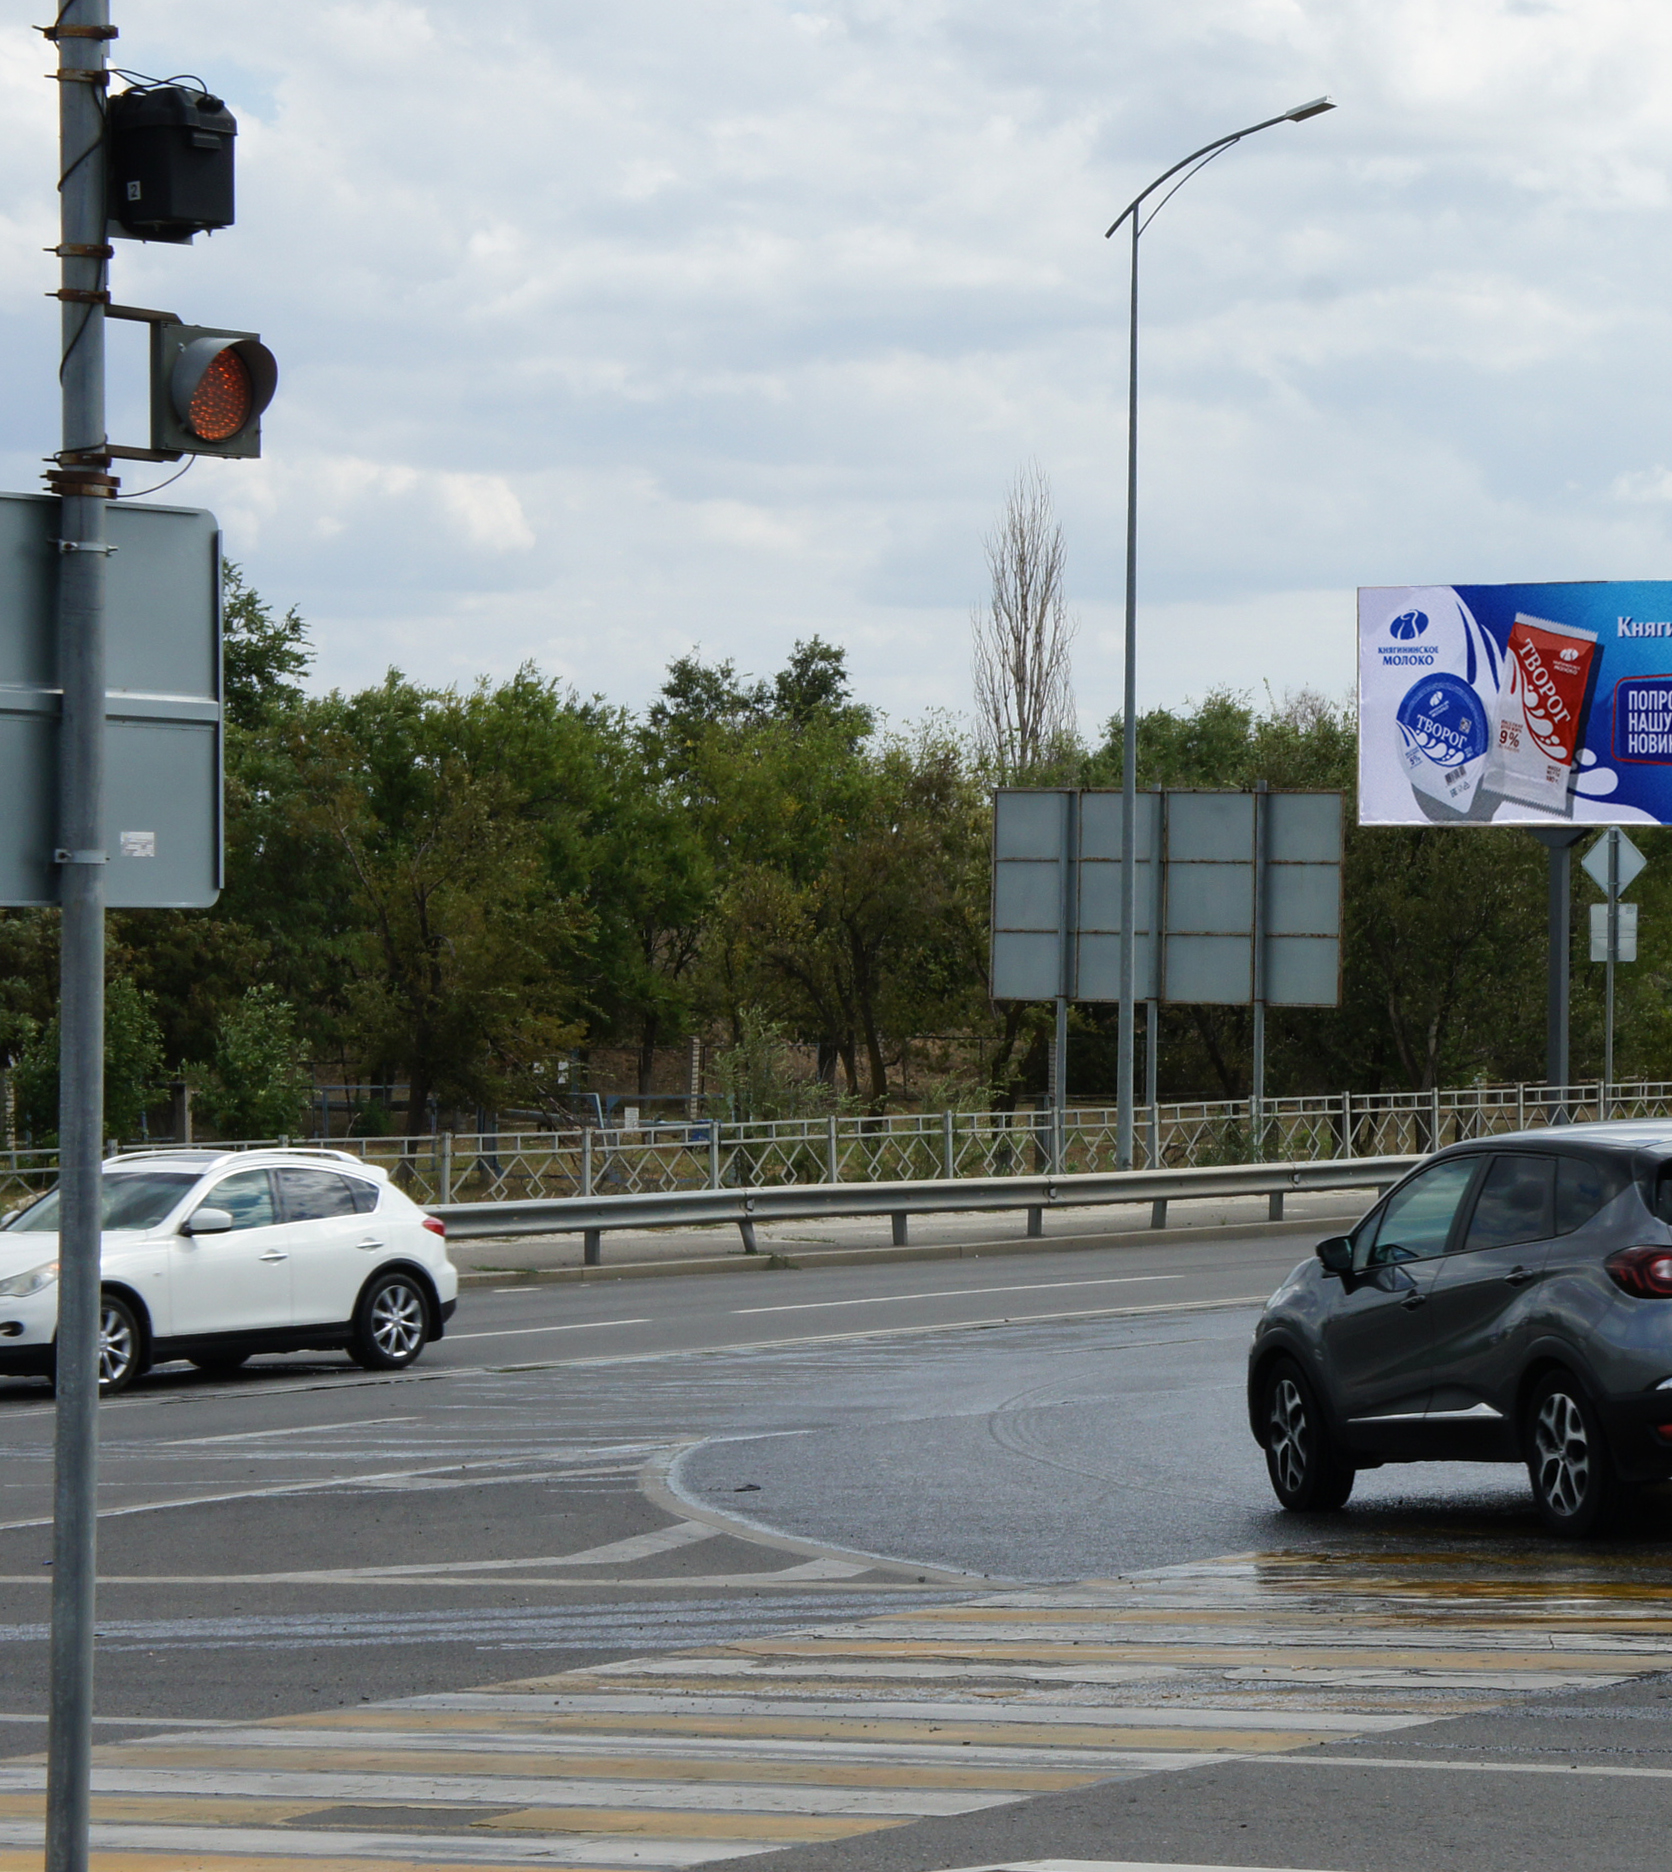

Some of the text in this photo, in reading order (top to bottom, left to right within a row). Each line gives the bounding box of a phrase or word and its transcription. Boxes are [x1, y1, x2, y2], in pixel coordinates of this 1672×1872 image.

[130, 184, 139, 198] 2
[1378, 646, 1439, 654] КНЯГИНИНСКОЕ
[1383, 655, 1434, 666] МОЛОКО
[1518, 638, 1571, 724] ТВОРОГ
[1628, 712, 1672, 732] НАШУ
[1417, 714, 1467, 748] ТВОРОГ
